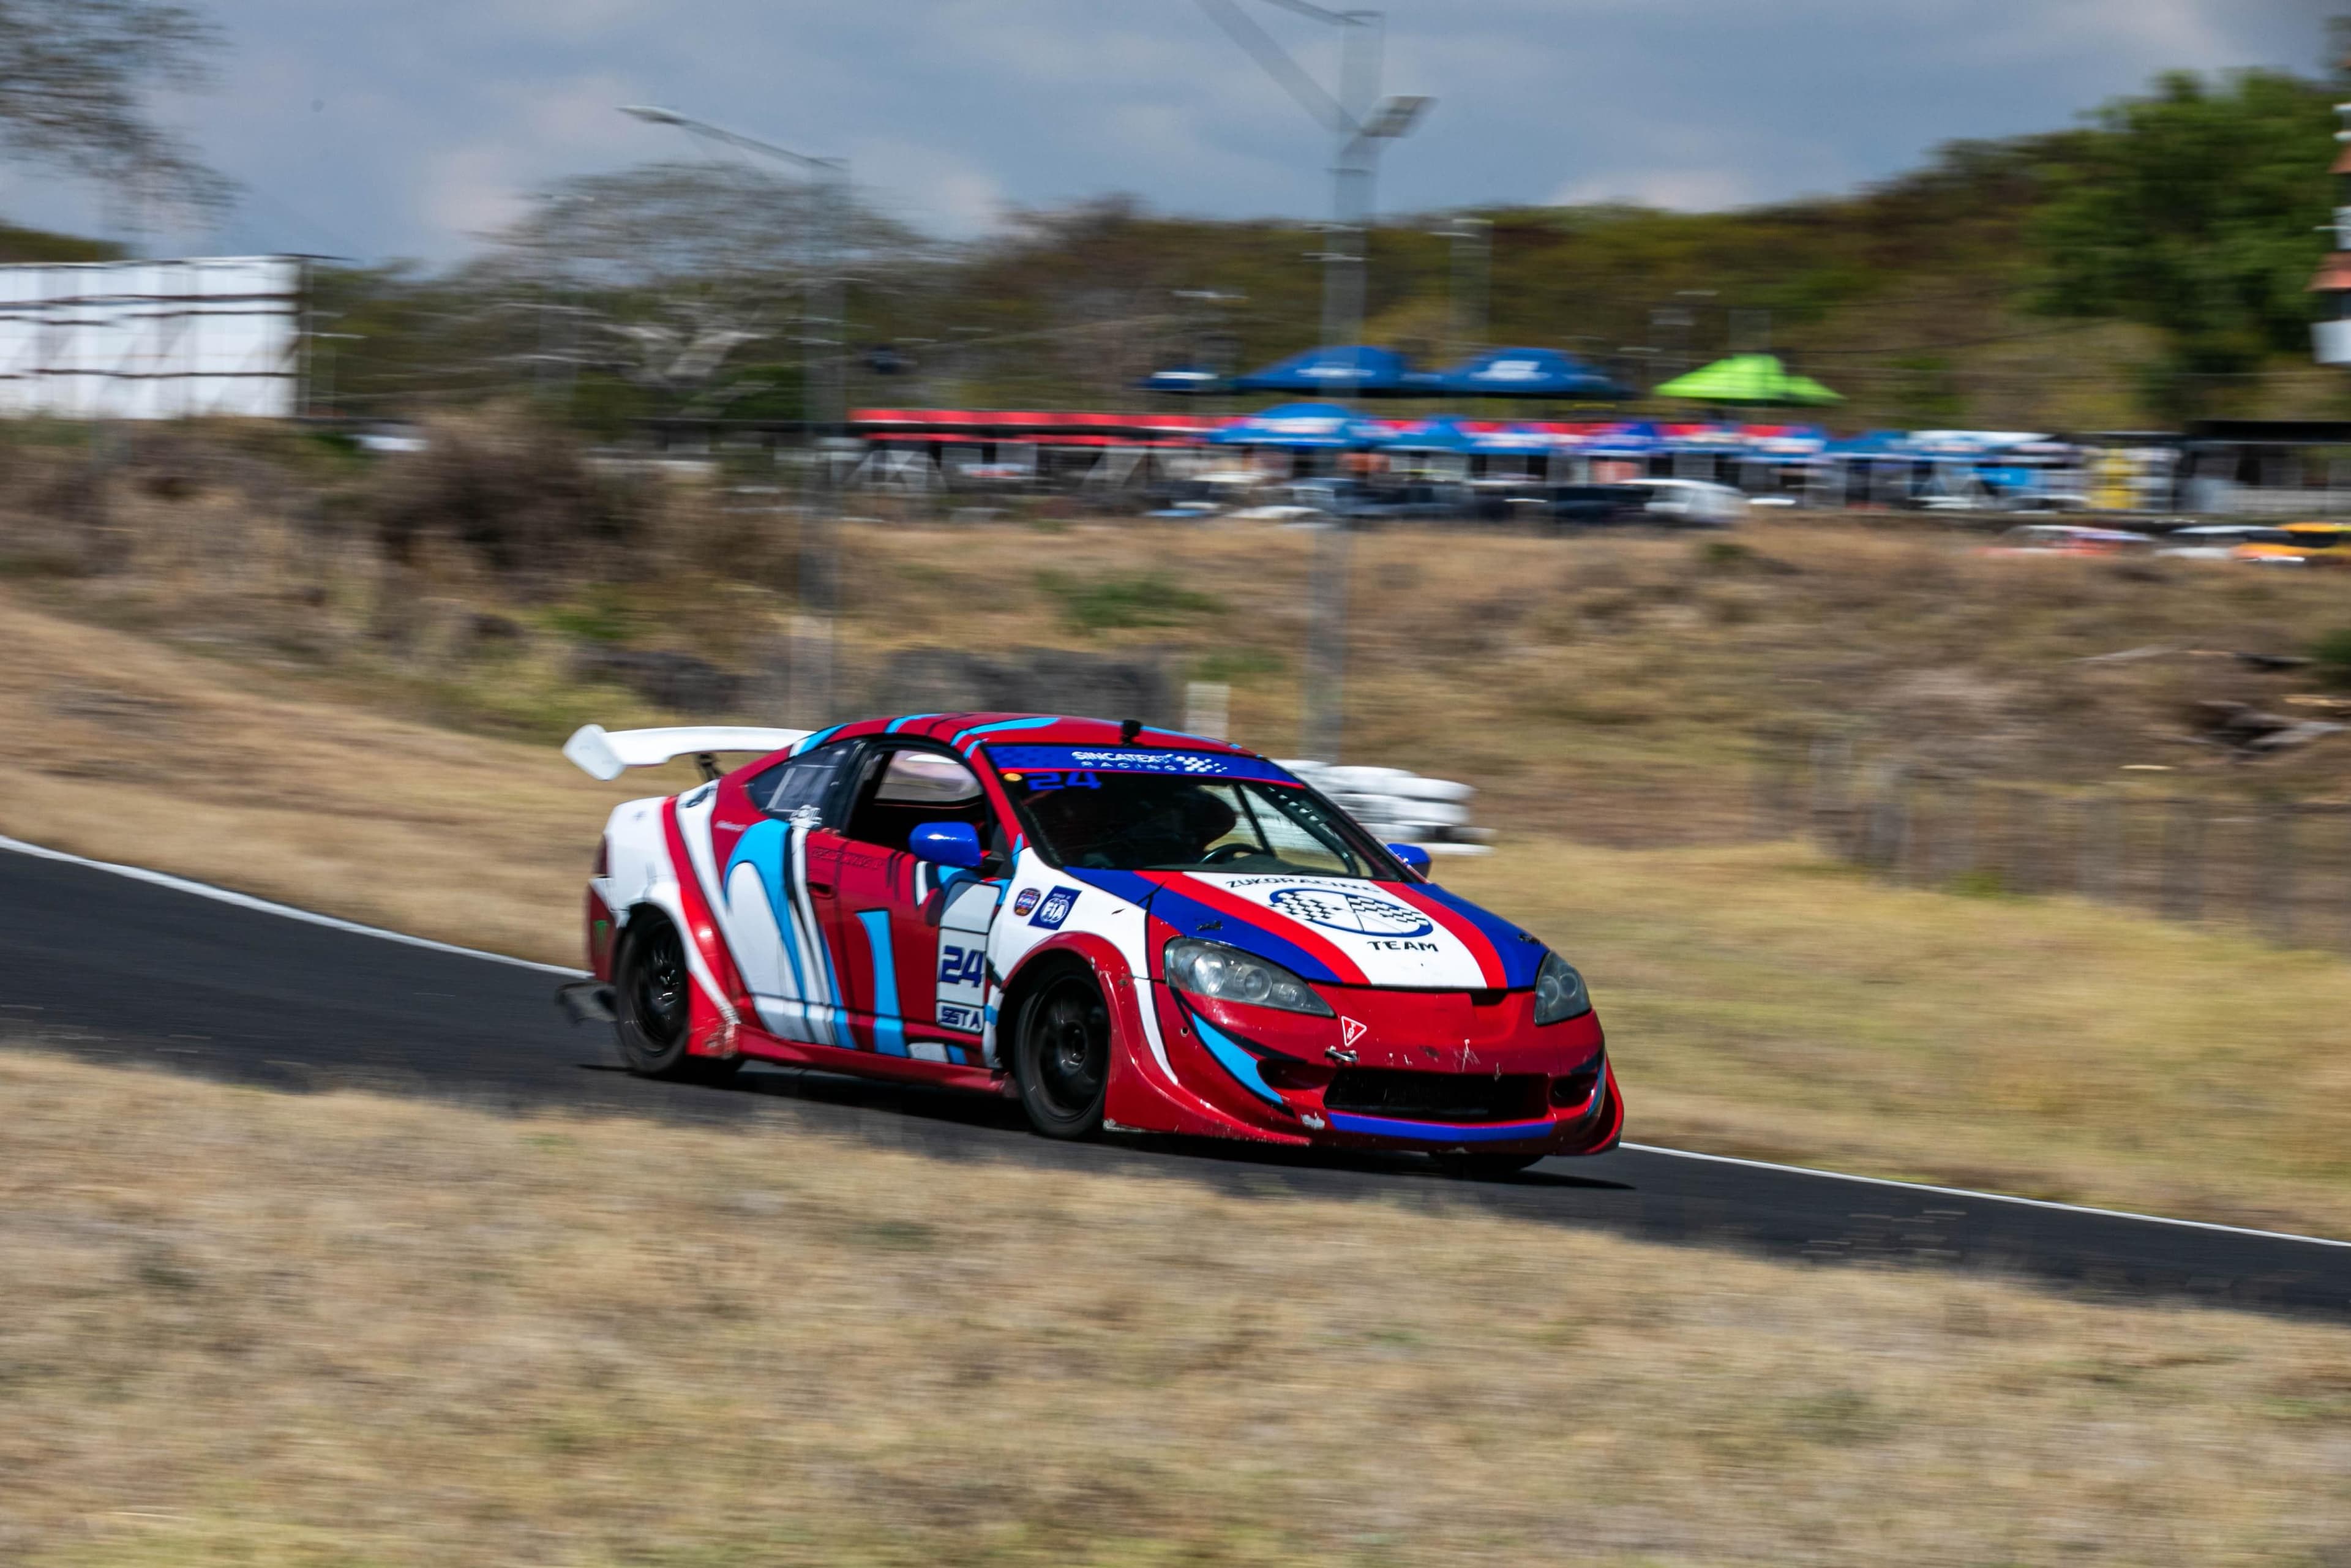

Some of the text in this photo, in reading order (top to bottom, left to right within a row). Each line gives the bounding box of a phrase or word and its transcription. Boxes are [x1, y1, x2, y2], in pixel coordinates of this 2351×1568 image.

[1024, 771, 1102, 791] 24
[1042, 900, 1065, 921] FIA
[1367, 940, 1439, 952] TEAM
[940, 945, 984, 988] 24
